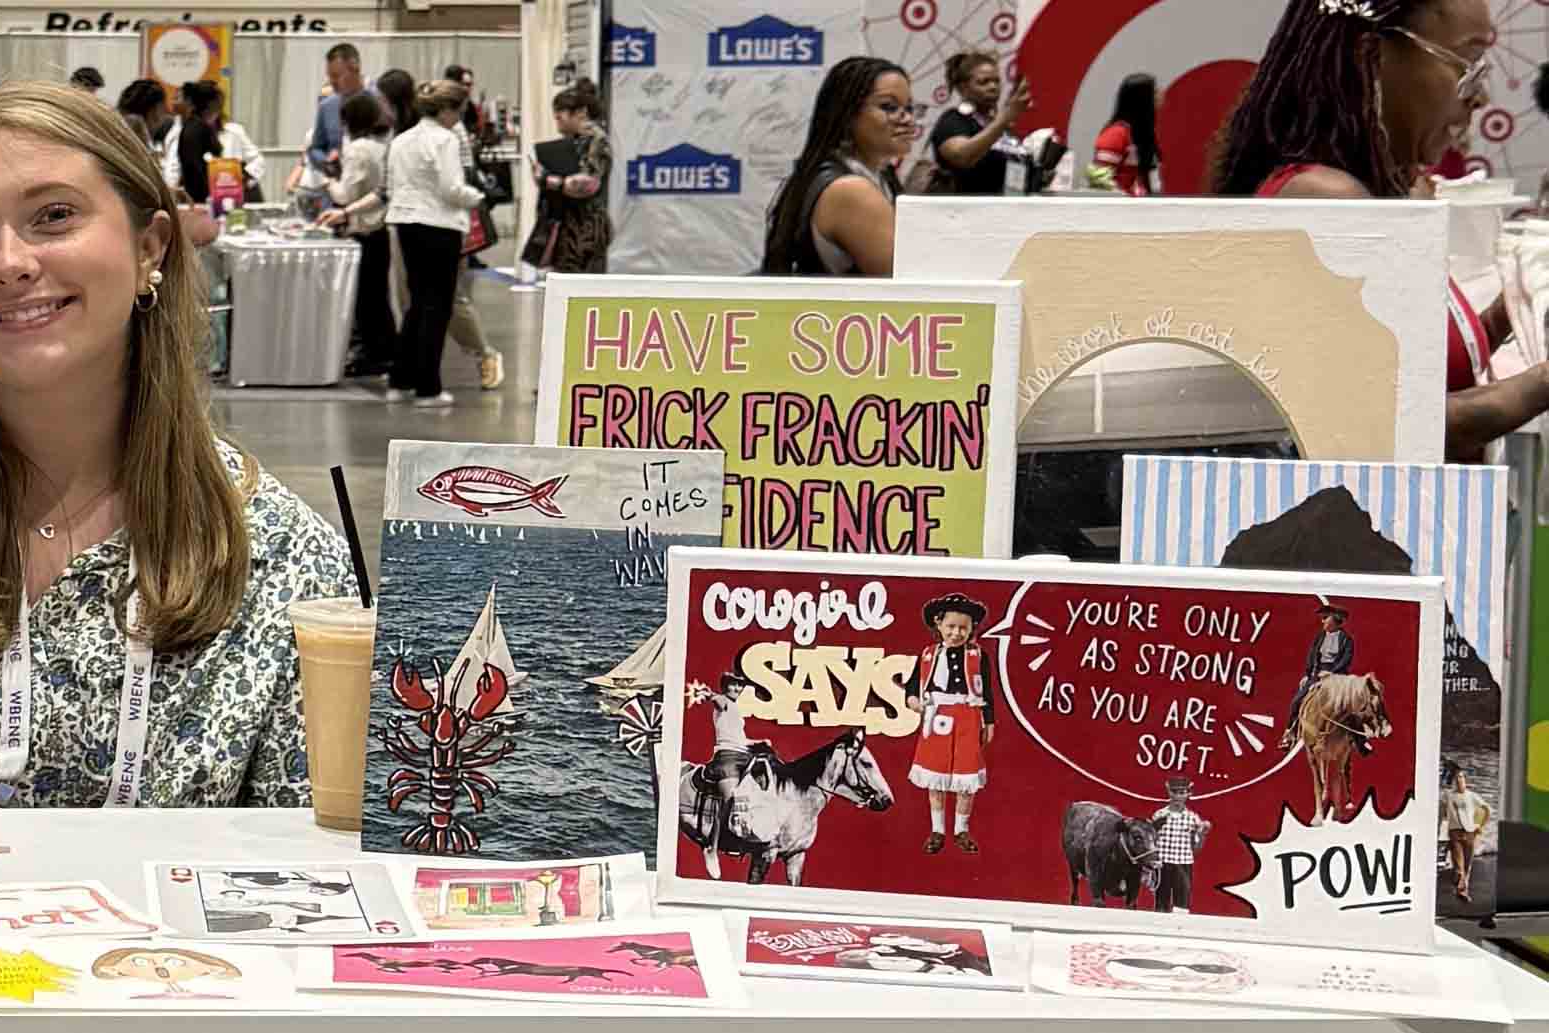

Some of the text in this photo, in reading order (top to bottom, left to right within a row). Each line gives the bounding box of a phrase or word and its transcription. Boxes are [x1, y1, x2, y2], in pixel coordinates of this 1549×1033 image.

[719, 35, 812, 61] LOWE'S
[638, 160, 730, 189] LOWE'S
[584, 307, 963, 380] HAVE SOME
[740, 384, 991, 471] FRACKIN'
[643, 459, 680, 491] IT
[619, 487, 708, 521] COMES
[625, 521, 653, 551] IN
[1066, 596, 1271, 643] YOU'RE ONLY
[128, 663, 146, 721] WBENC
[735, 640, 923, 738] SAYS
[1079, 638, 1256, 695] AS STRONG
[7, 690, 24, 749] WBENC
[1036, 675, 1218, 735] AS YOU ARE
[1135, 733, 1230, 780] SOFT...
[1273, 834, 1413, 910] POW!
